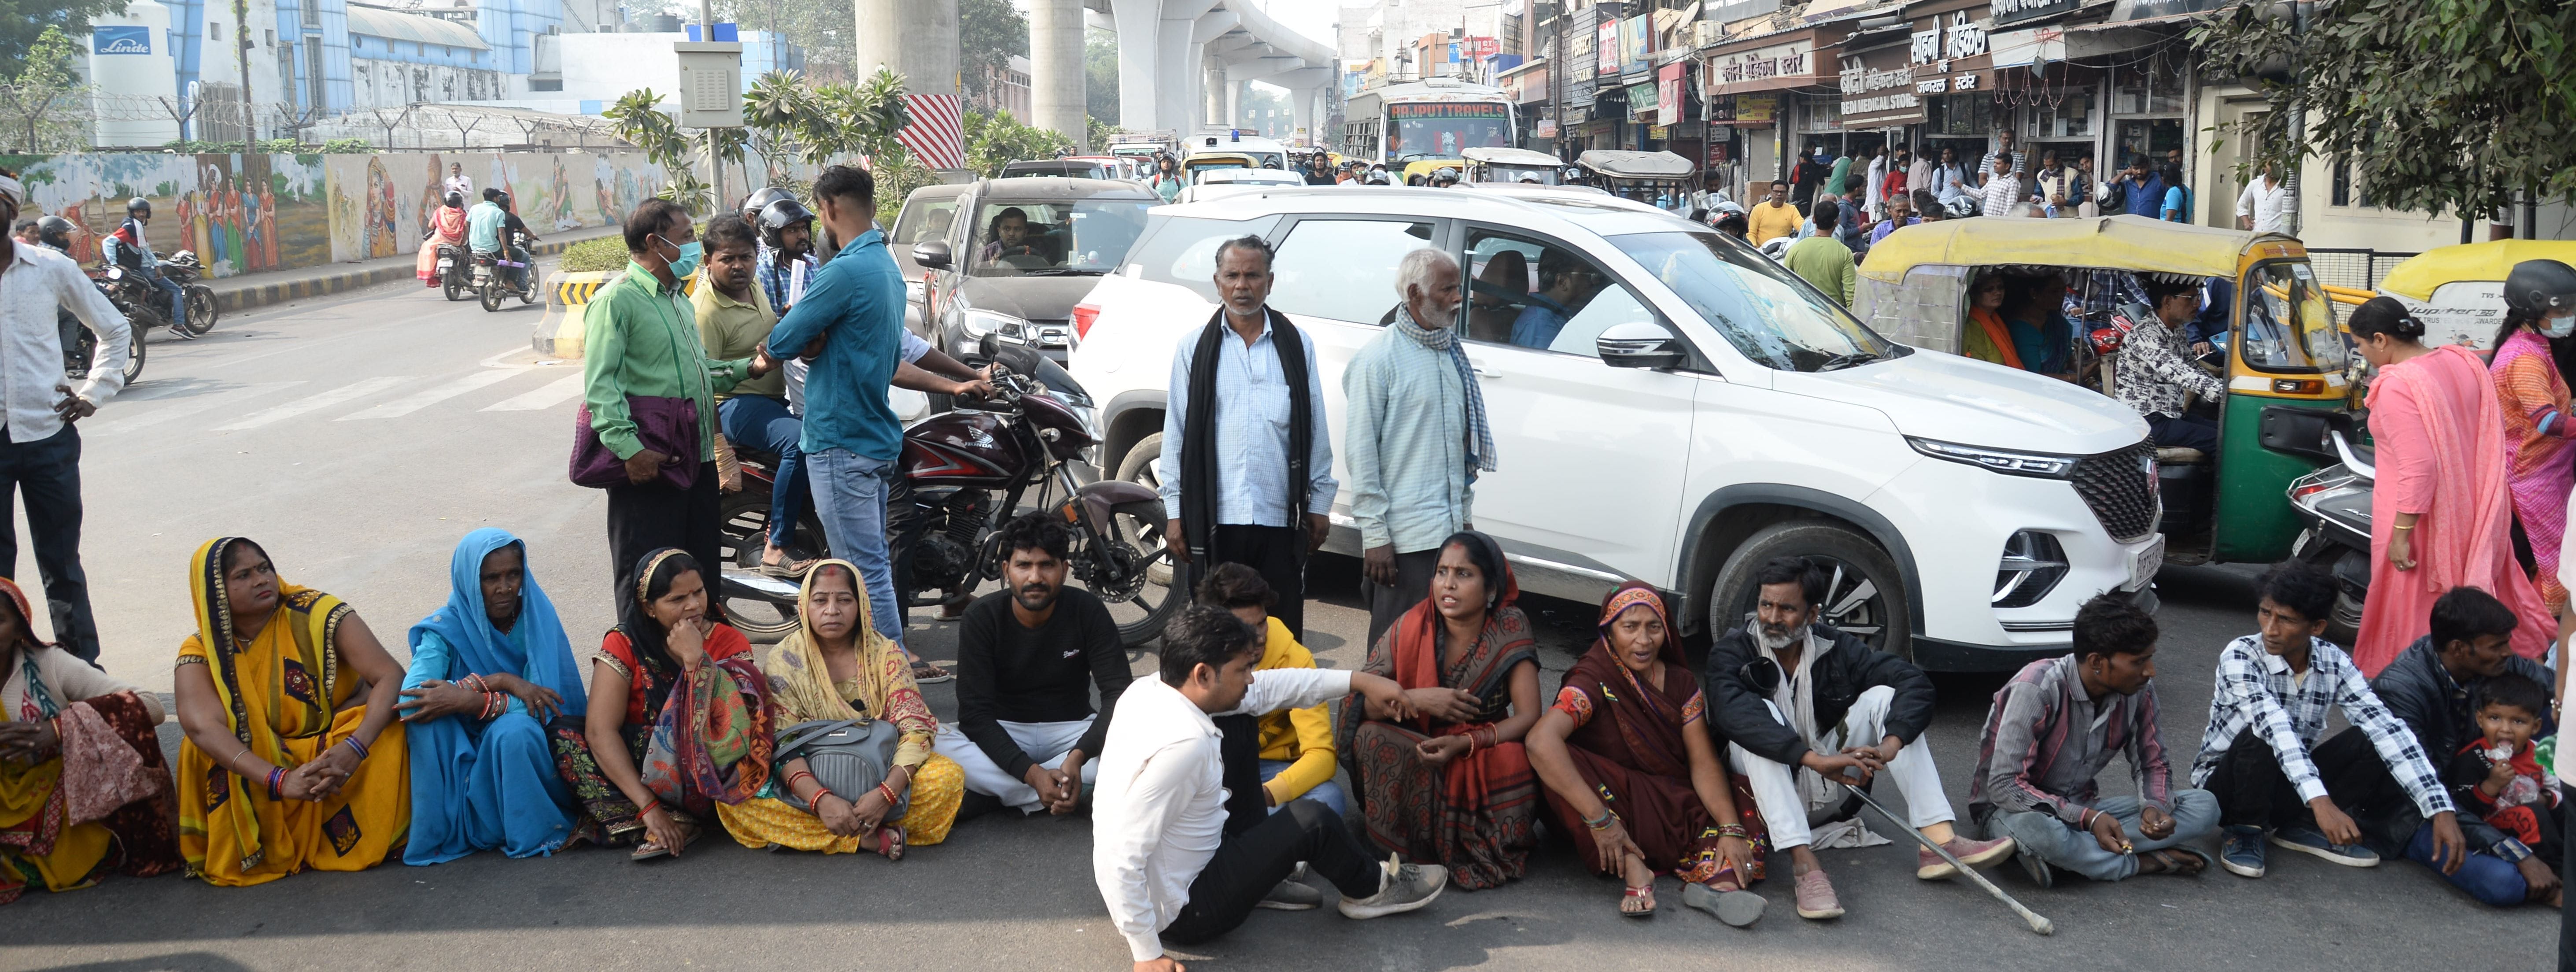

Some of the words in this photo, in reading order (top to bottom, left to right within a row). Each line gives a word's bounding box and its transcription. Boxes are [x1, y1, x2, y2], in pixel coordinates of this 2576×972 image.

[100, 38, 148, 53] Linde
[1571, 33, 1592, 58] PERFECT
[1911, 15, 1940, 65] साहनी
[1947, 11, 1985, 59] मेडिकल
[1720, 56, 1742, 82] नवीन
[1744, 52, 1777, 81] मेडिकल
[1779, 48, 1804, 75] स्टोर
[1839, 56, 1866, 95] बेदी
[1865, 67, 1893, 90] मेडिकल
[1916, 78, 1946, 93] जनरल
[1955, 71, 1976, 90] स्टोर
[1391, 105, 1443, 118] RAJPUT
[1446, 105, 1505, 118] TRAVELS
[1841, 100, 1857, 115] BEDI
[1858, 96, 1889, 113] MEDICAL
[1890, 93, 1918, 109] STORE
